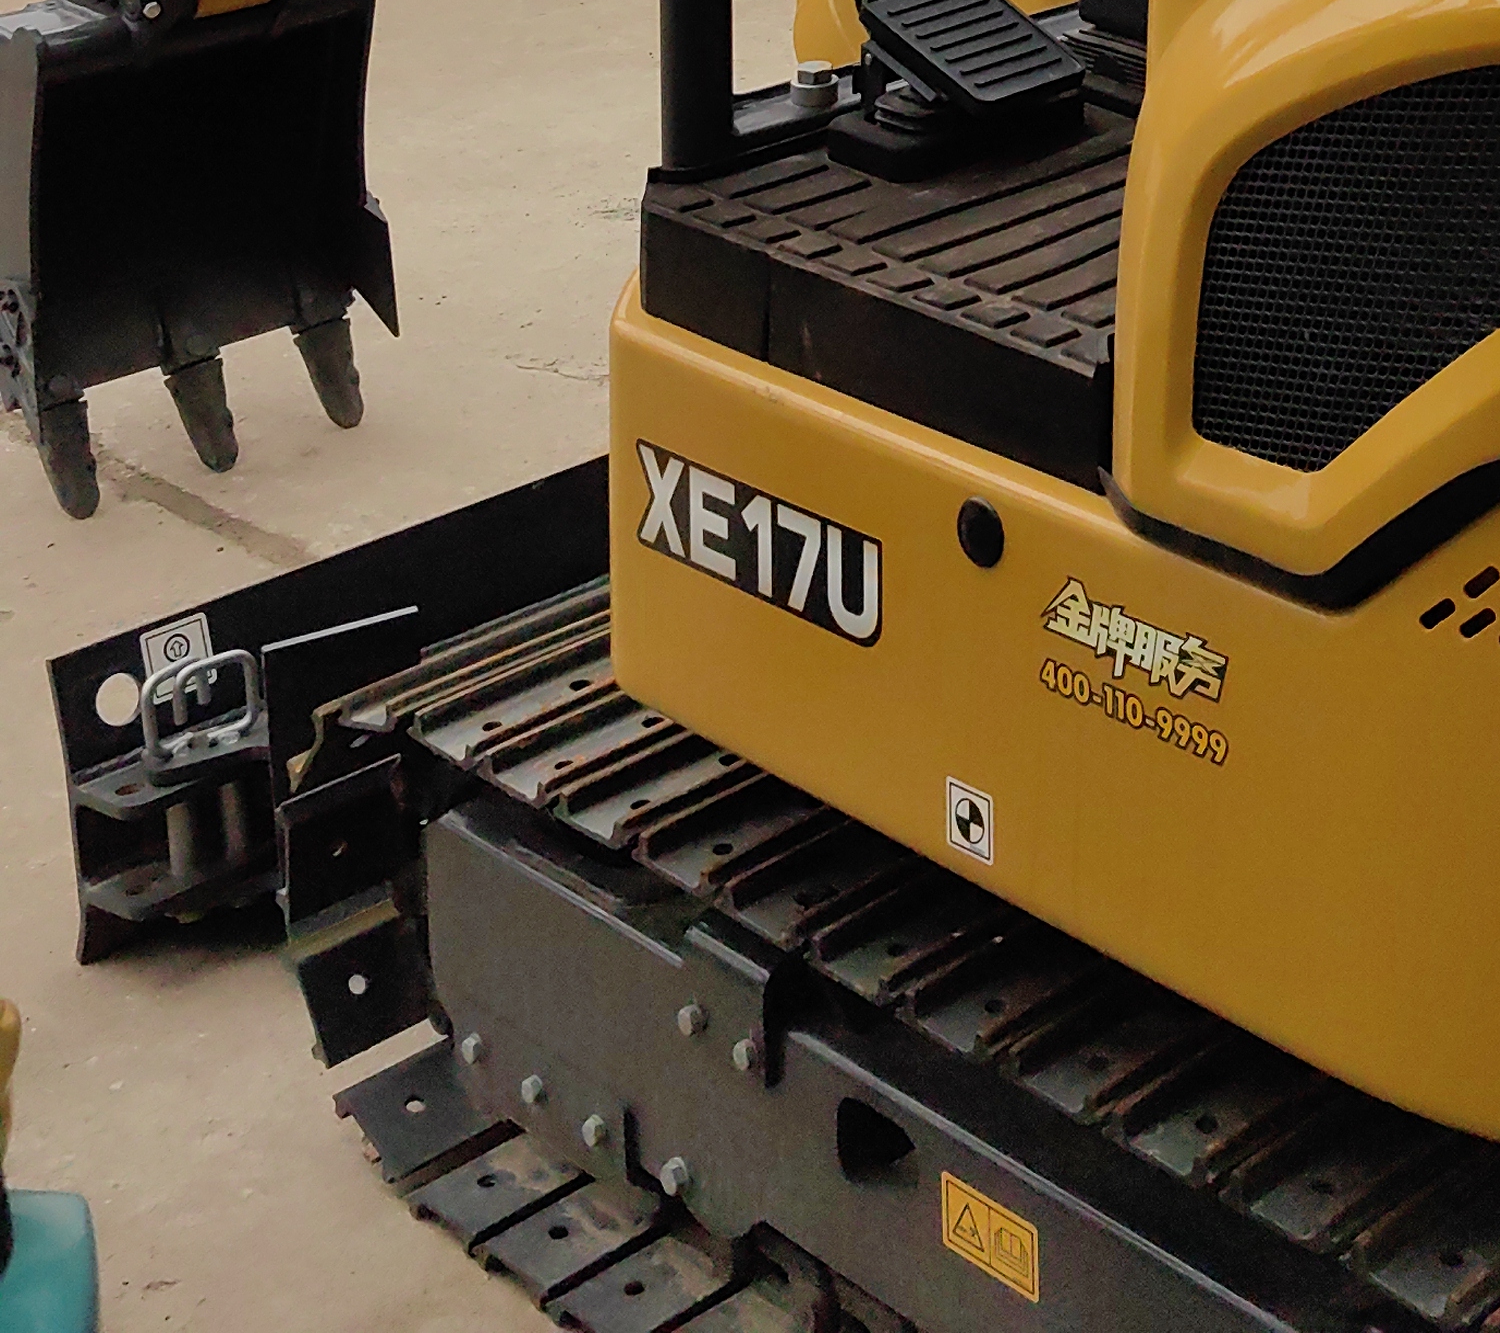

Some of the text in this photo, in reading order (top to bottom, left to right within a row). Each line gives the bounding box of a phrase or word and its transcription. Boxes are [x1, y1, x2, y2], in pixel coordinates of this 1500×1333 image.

[638, 443, 879, 640] XE17U
[1043, 577, 1227, 702] 金牌服务
[1040, 658, 1229, 766] 400-110-9999
